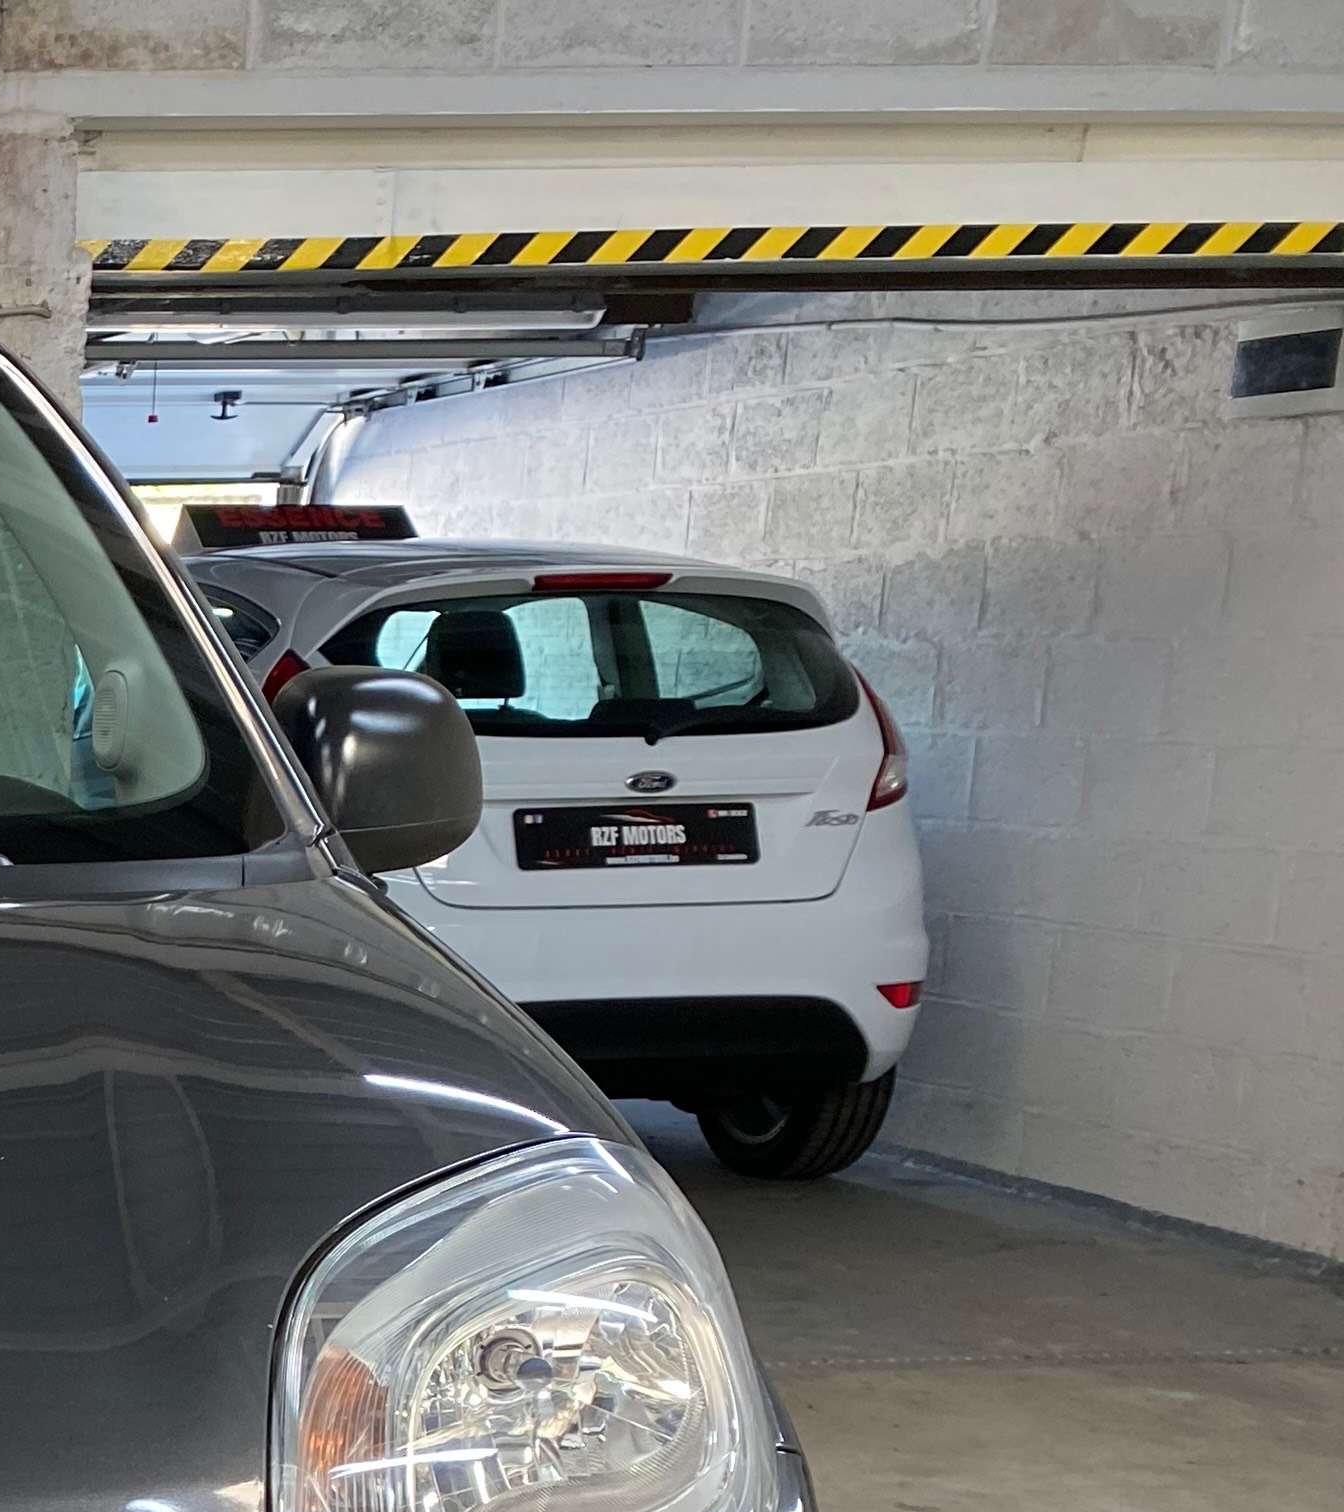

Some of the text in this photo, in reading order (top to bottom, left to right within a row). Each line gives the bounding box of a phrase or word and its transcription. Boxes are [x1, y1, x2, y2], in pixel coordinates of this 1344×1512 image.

[216, 506, 385, 528] ESSENCE
[259, 531, 359, 544] RZF MOTORS
[590, 824, 688, 847] RZF MOTORS
